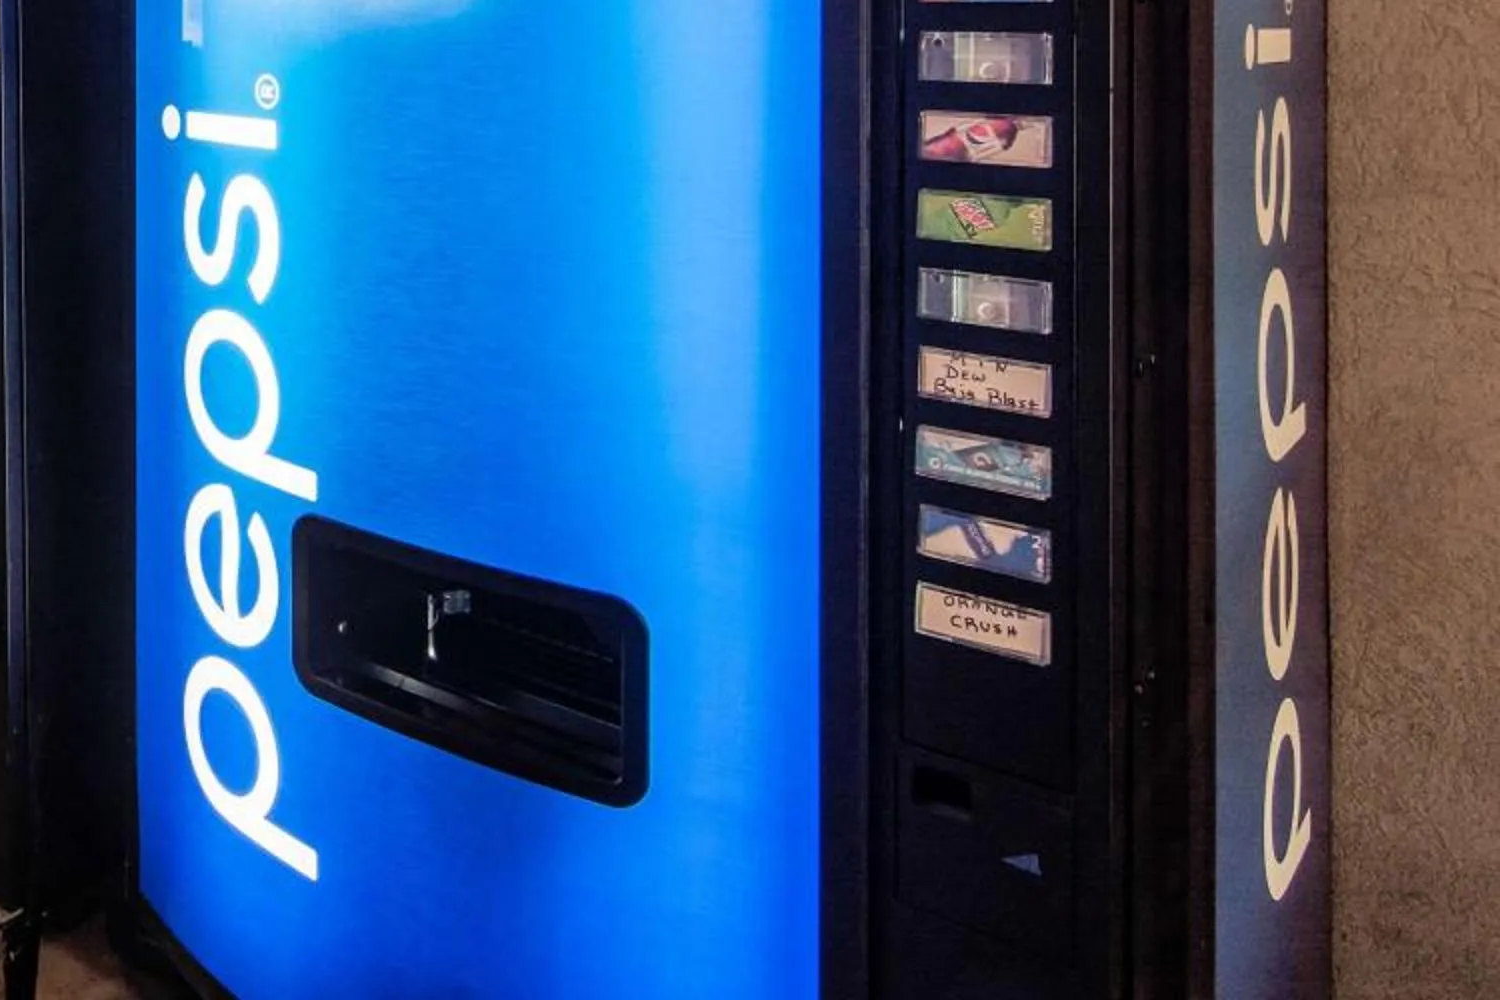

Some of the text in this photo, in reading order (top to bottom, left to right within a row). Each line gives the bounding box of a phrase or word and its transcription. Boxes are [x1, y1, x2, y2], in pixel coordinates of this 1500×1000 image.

[162, 106, 318, 881] pepsi
[949, 615, 1018, 638] CRUSH
[1245, 24, 1311, 901] pepsi
